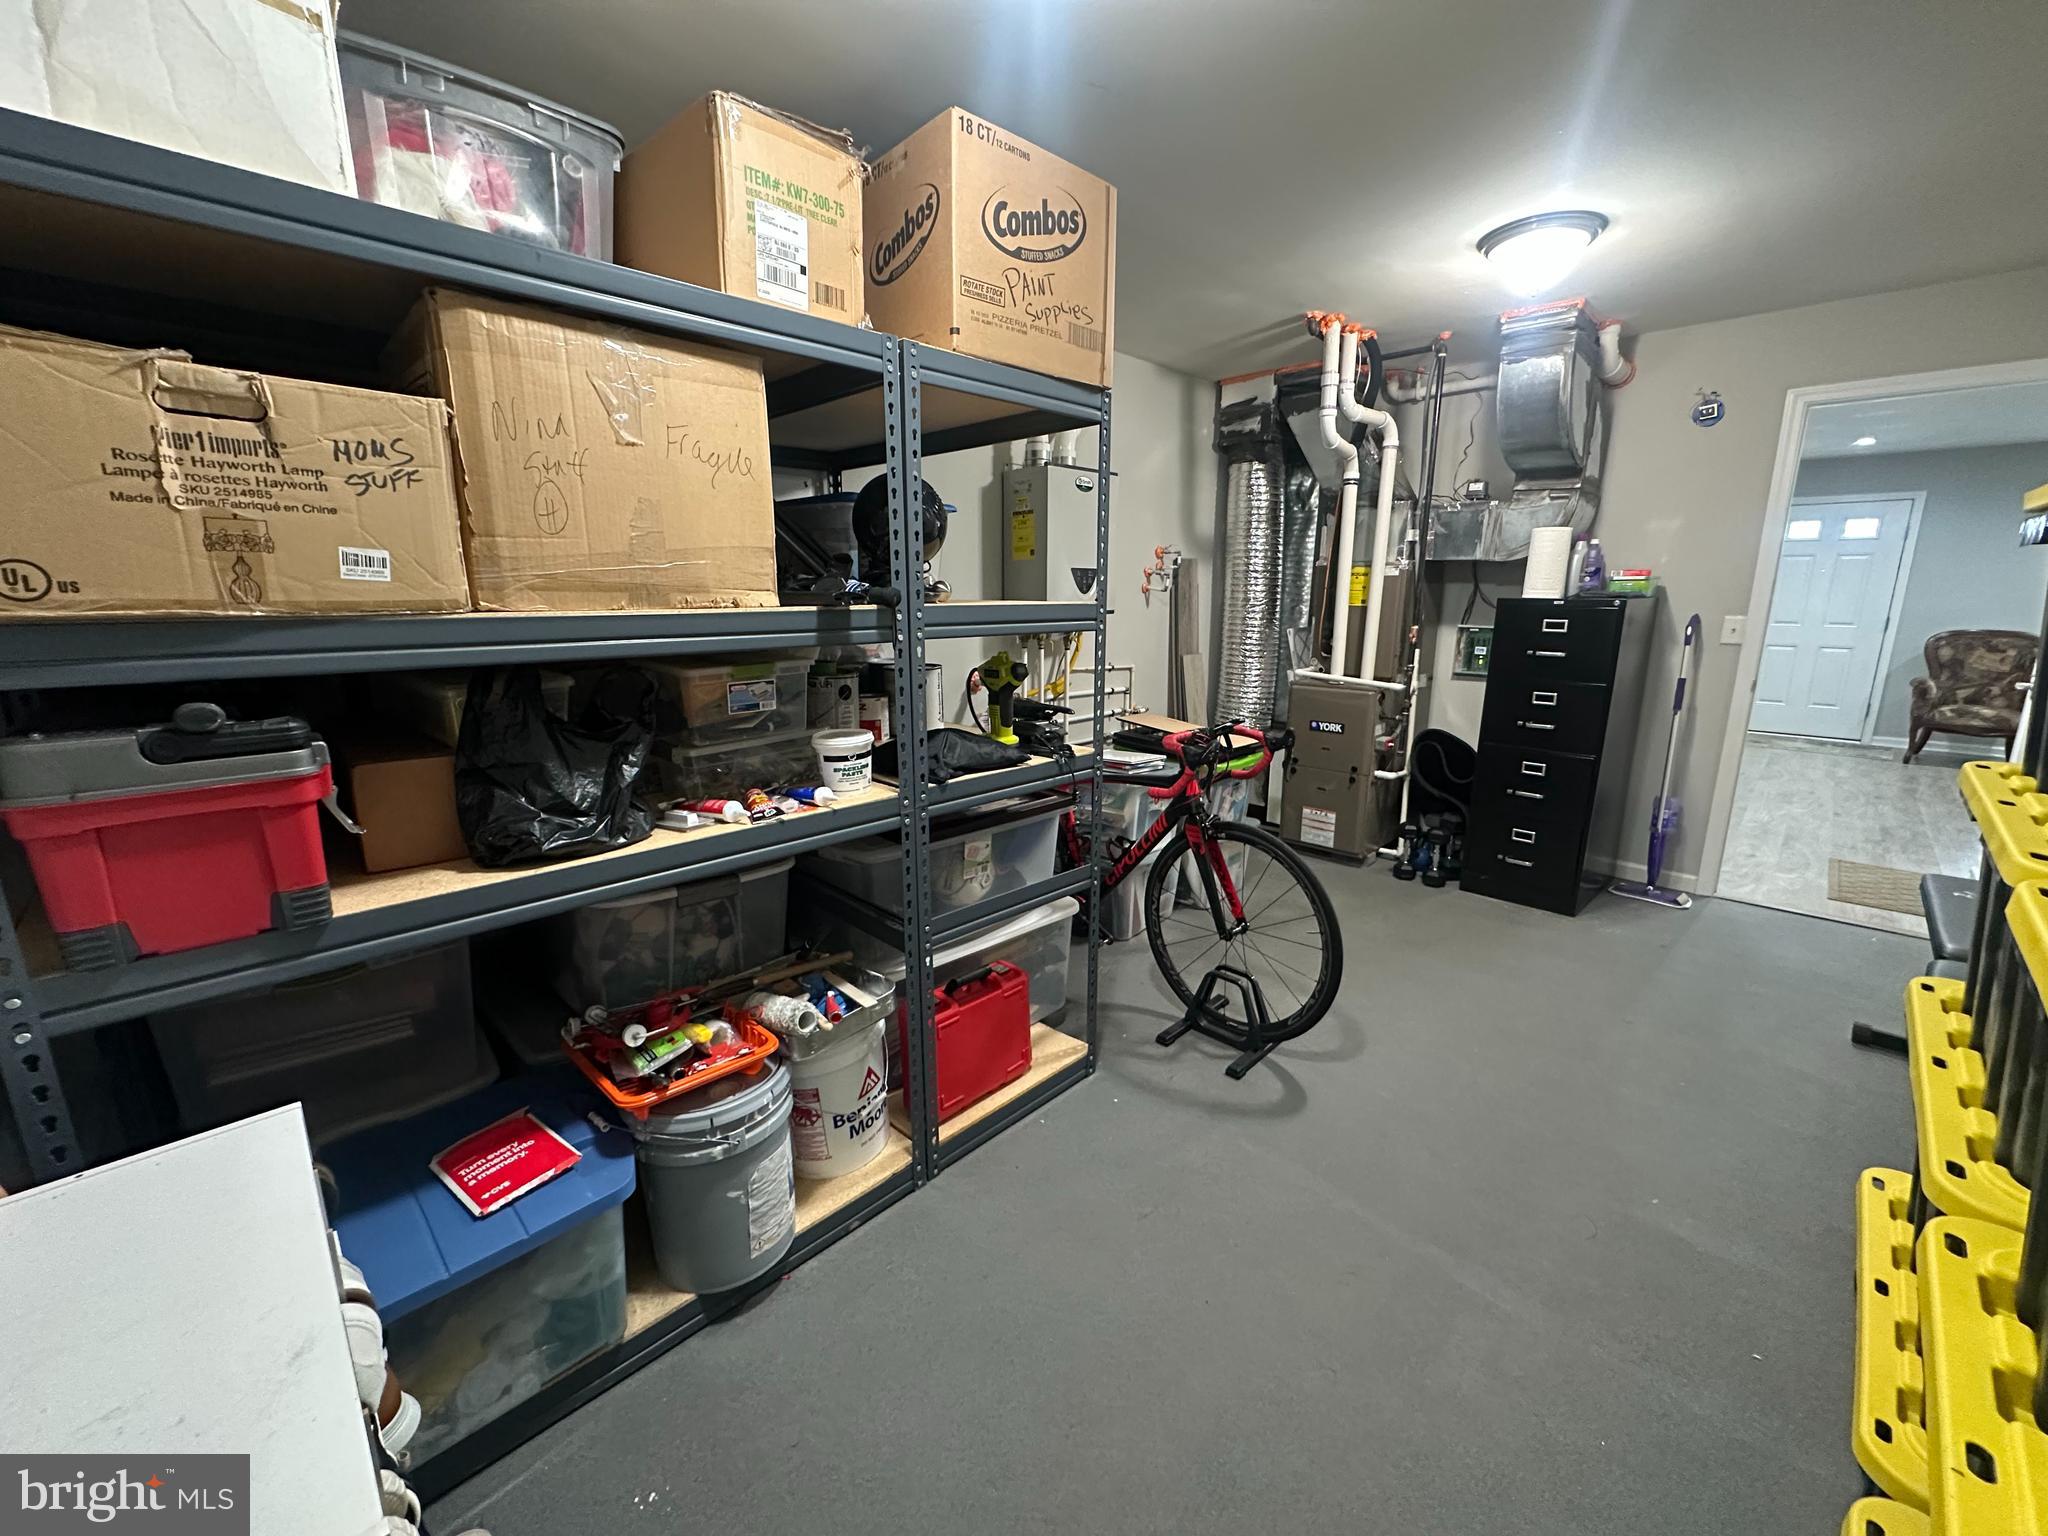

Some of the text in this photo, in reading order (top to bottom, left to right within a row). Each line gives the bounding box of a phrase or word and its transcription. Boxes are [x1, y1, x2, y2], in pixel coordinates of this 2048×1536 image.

[958, 115, 973, 135] 18
[1004, 142, 1031, 162] CARTONS
[743, 165, 785, 196] ITEM#:
[786, 181, 845, 219] KW7-300-75
[992, 198, 1080, 238] Combos
[875, 192, 934, 276] Combos
[1020, 248, 1065, 261] STUFFED SNACKS
[963, 279, 1004, 298] ROTATE STOCK
[1001, 267, 1055, 308] PAINT
[991, 312, 1028, 330] PIZZERIA
[1029, 324, 1064, 340] PRETZEL
[100, 462, 328, 493] Lampe à rosettes Hayworth
[110, 447, 325, 479] Rosette Hayworth Lamp
[109, 490, 154, 504] Made
[156, 495, 172, 505] in
[283, 504, 300, 514] en
[301, 503, 338, 515] Chine
[178, 484, 273, 500] SKU 2514985
[1, 567, 38, 593] UL
[1318, 721, 1343, 733] YORK
[841, 770, 864, 778] PASTE
[457, 1141, 519, 1177] Turn every
[463, 1140, 535, 1182] moment into
[467, 1150, 529, 1187] a memory.
[490, 1180, 512, 1195] CVS
